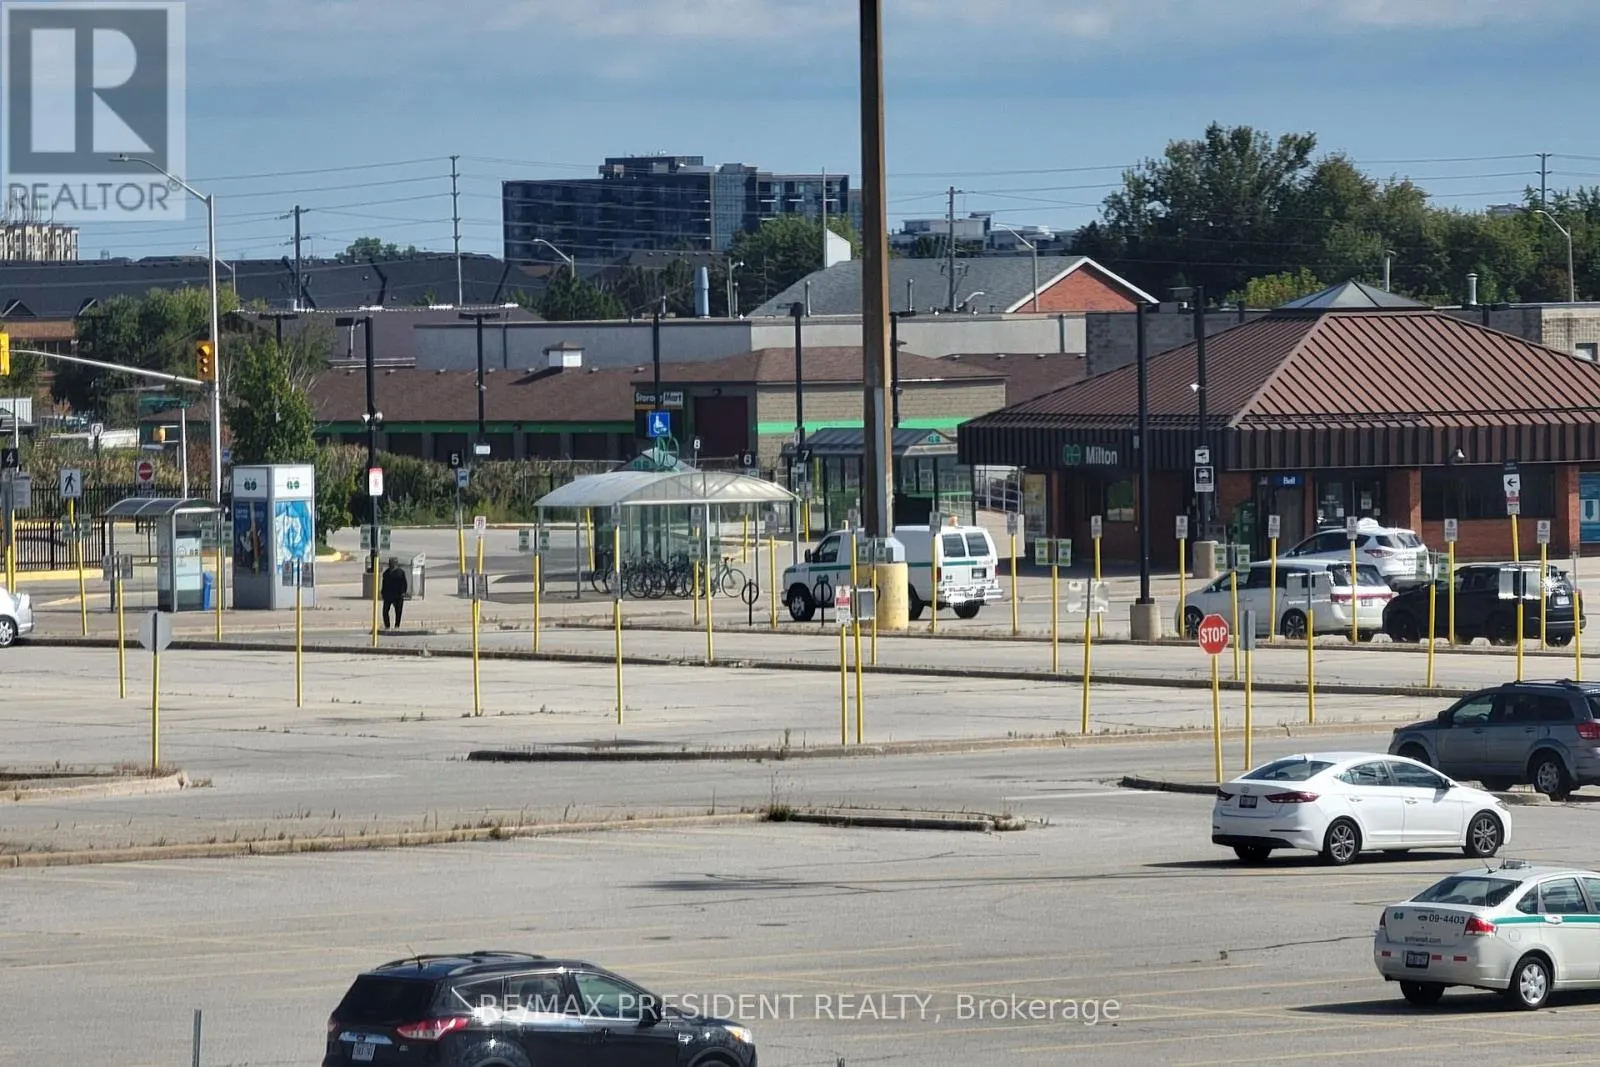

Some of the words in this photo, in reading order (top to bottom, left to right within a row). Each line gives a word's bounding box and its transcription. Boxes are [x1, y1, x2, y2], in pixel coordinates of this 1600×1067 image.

[6, 452, 14, 464] 4
[451, 454, 459, 465] 5
[743, 454, 752, 465] 6
[801, 450, 809, 460] 7
[1085, 446, 1118, 465] Milton
[1283, 476, 1295, 484] Bell
[1201, 626, 1227, 644] STOP
[1429, 914, 1465, 925] 09-4403
